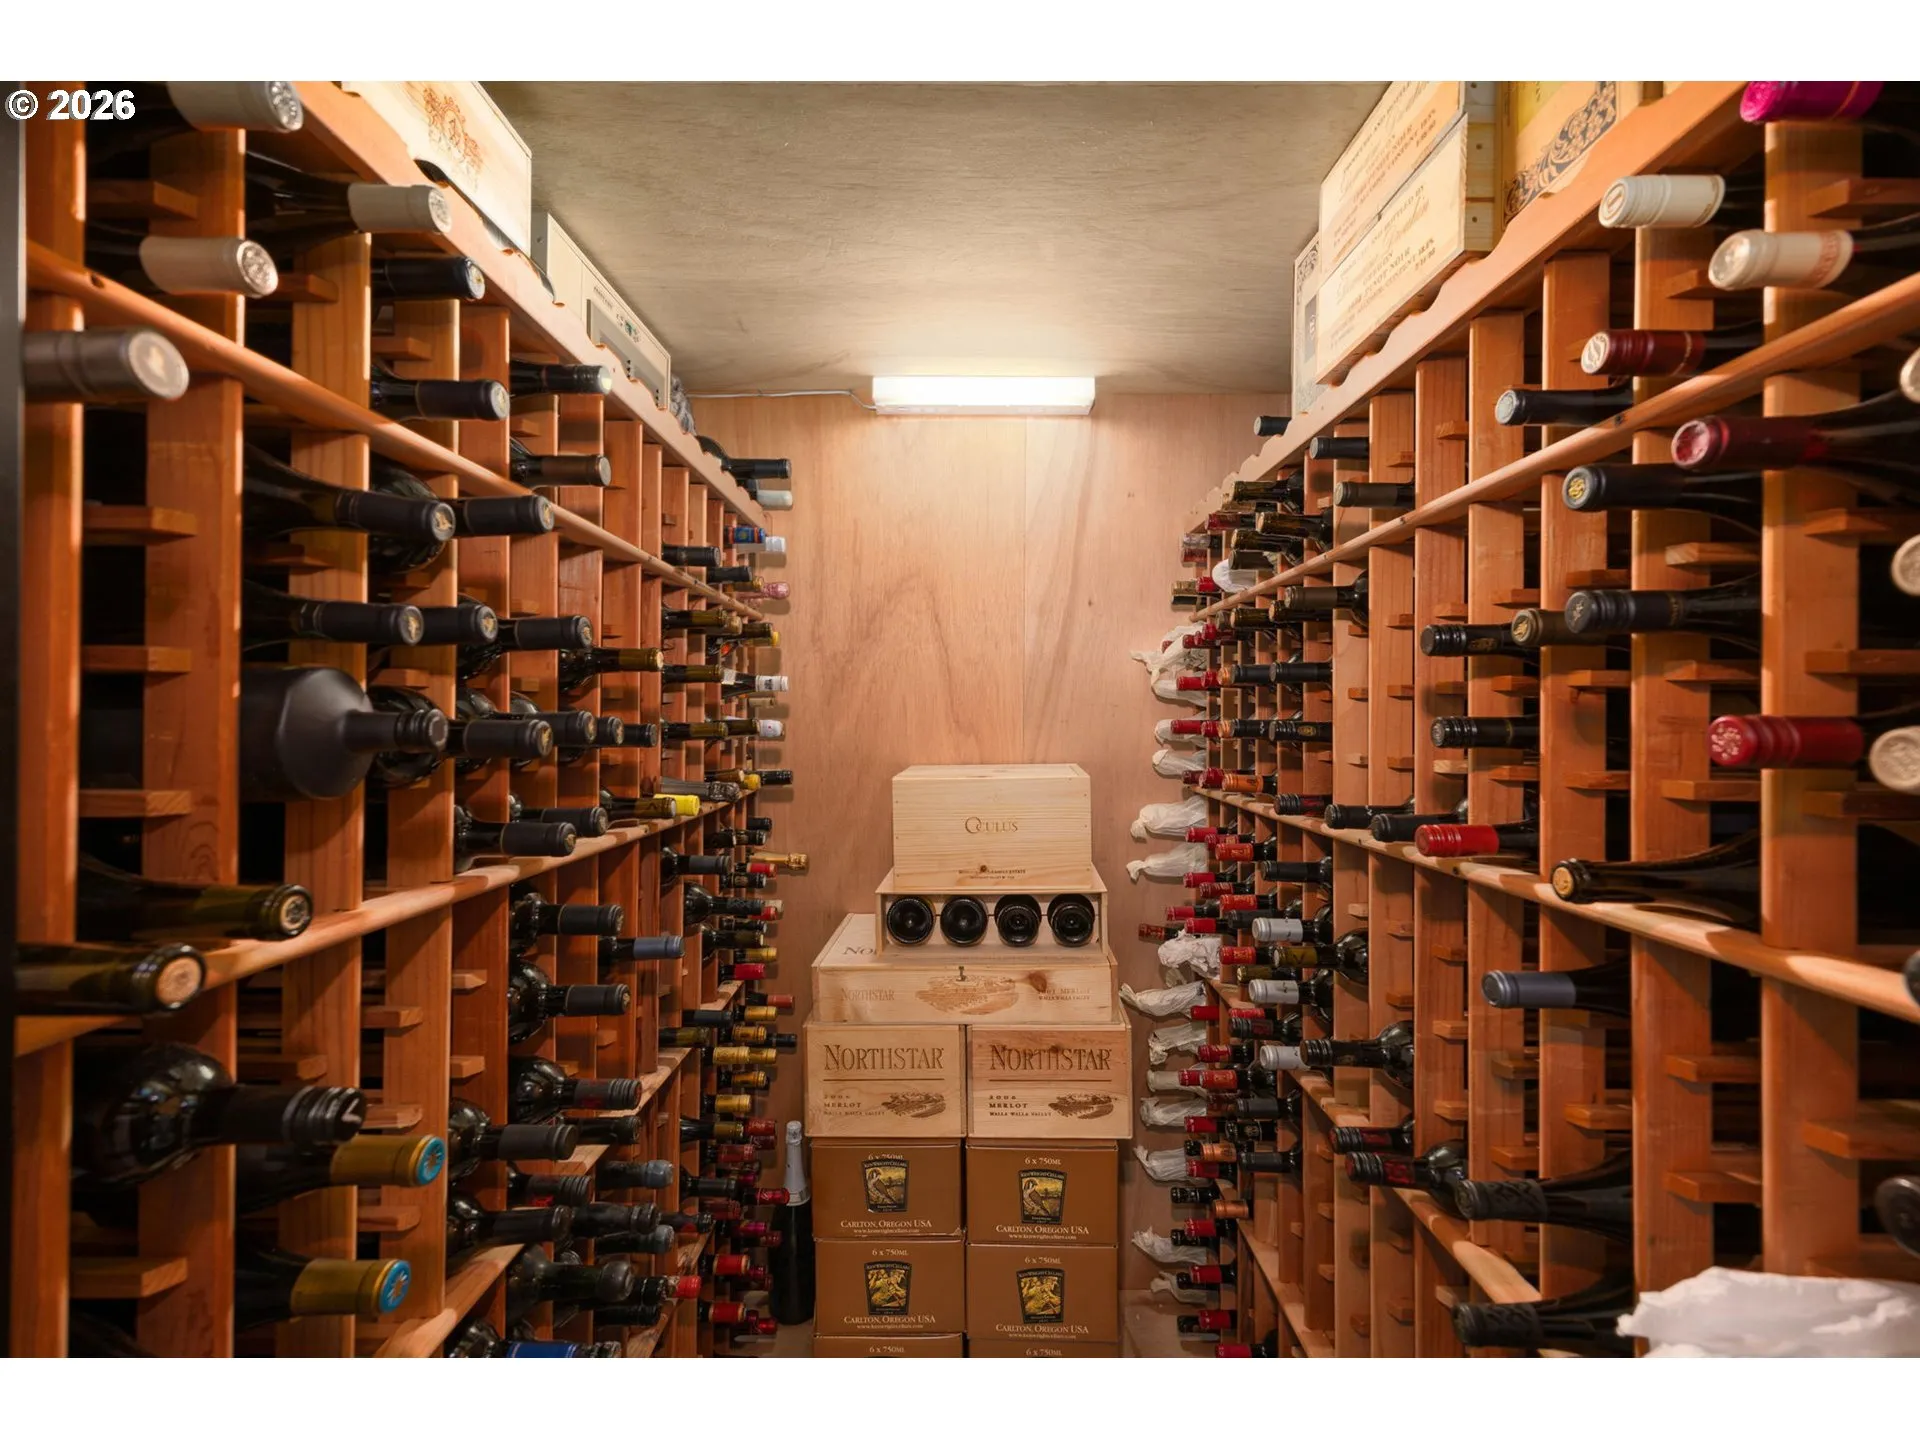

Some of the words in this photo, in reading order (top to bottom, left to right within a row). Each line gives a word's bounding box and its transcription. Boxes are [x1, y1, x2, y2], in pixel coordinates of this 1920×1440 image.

[842, 988, 895, 1001] NORTHSTAR
[823, 1044, 944, 1071] NORTHSTAR
[989, 1044, 1112, 1071] NORTHSTAR
[840, 1220, 878, 1228] CARLTON,
[878, 1219, 912, 1228] OREGON
[914, 1219, 932, 1227] USA
[996, 1225, 1034, 1234] CARLTON,
[1034, 1225, 1069, 1234] OREGON
[1071, 1226, 1089, 1235] USA
[882, 1315, 916, 1323] OREGON
[918, 1315, 936, 1323] USA
[1034, 1325, 1069, 1333] OREGON
[1071, 1325, 1089, 1334] USA
